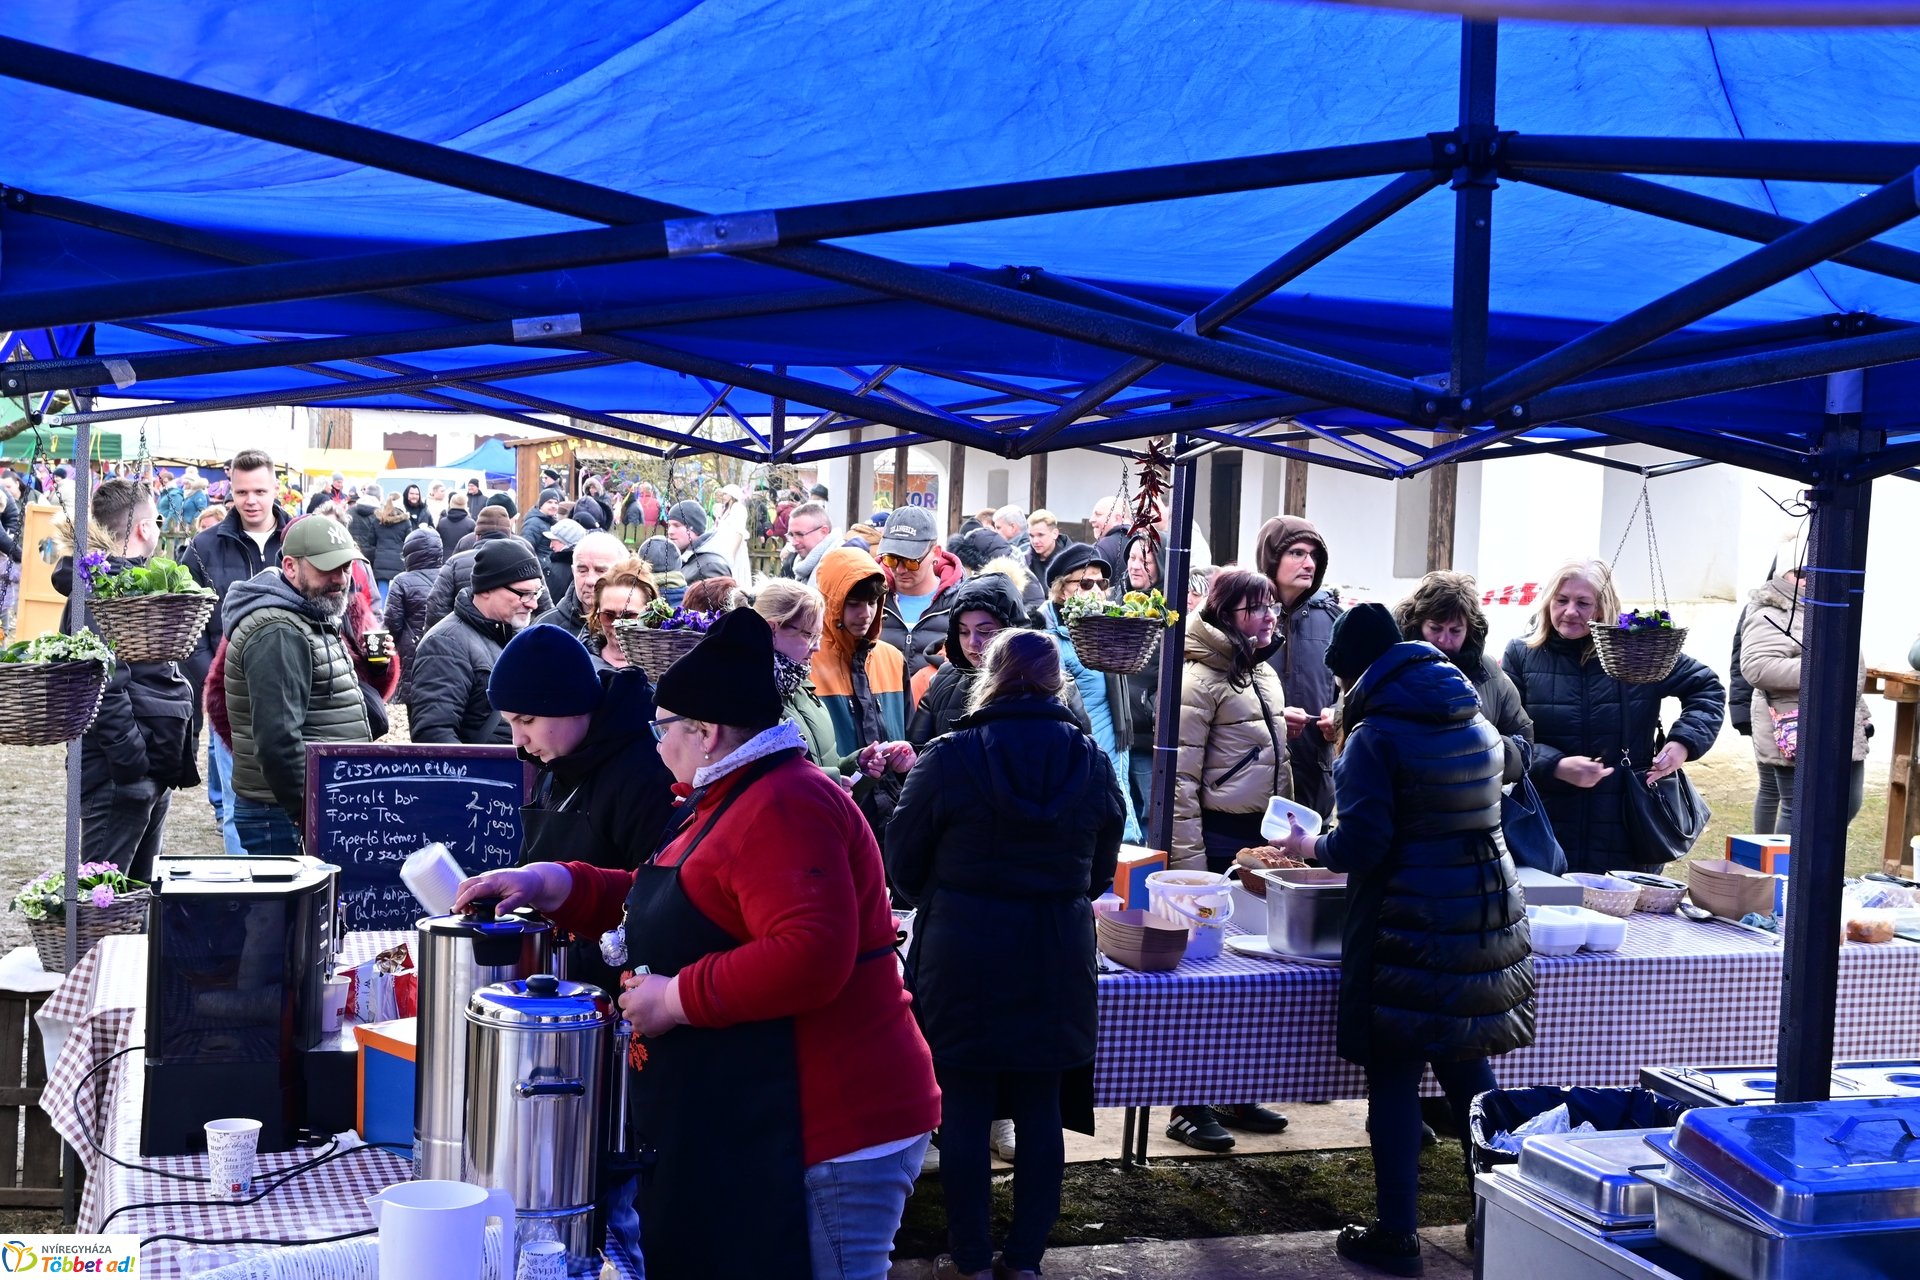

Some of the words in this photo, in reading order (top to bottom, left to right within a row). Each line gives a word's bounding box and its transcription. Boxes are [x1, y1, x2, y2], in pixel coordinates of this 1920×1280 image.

[326, 788, 385, 805] Forralt
[465, 791, 484, 811] 2
[371, 807, 405, 824] Tea
[467, 812, 478, 829] 1
[483, 820, 516, 840] jegy
[465, 835, 476, 855] 1
[481, 844, 512, 866] jegy
